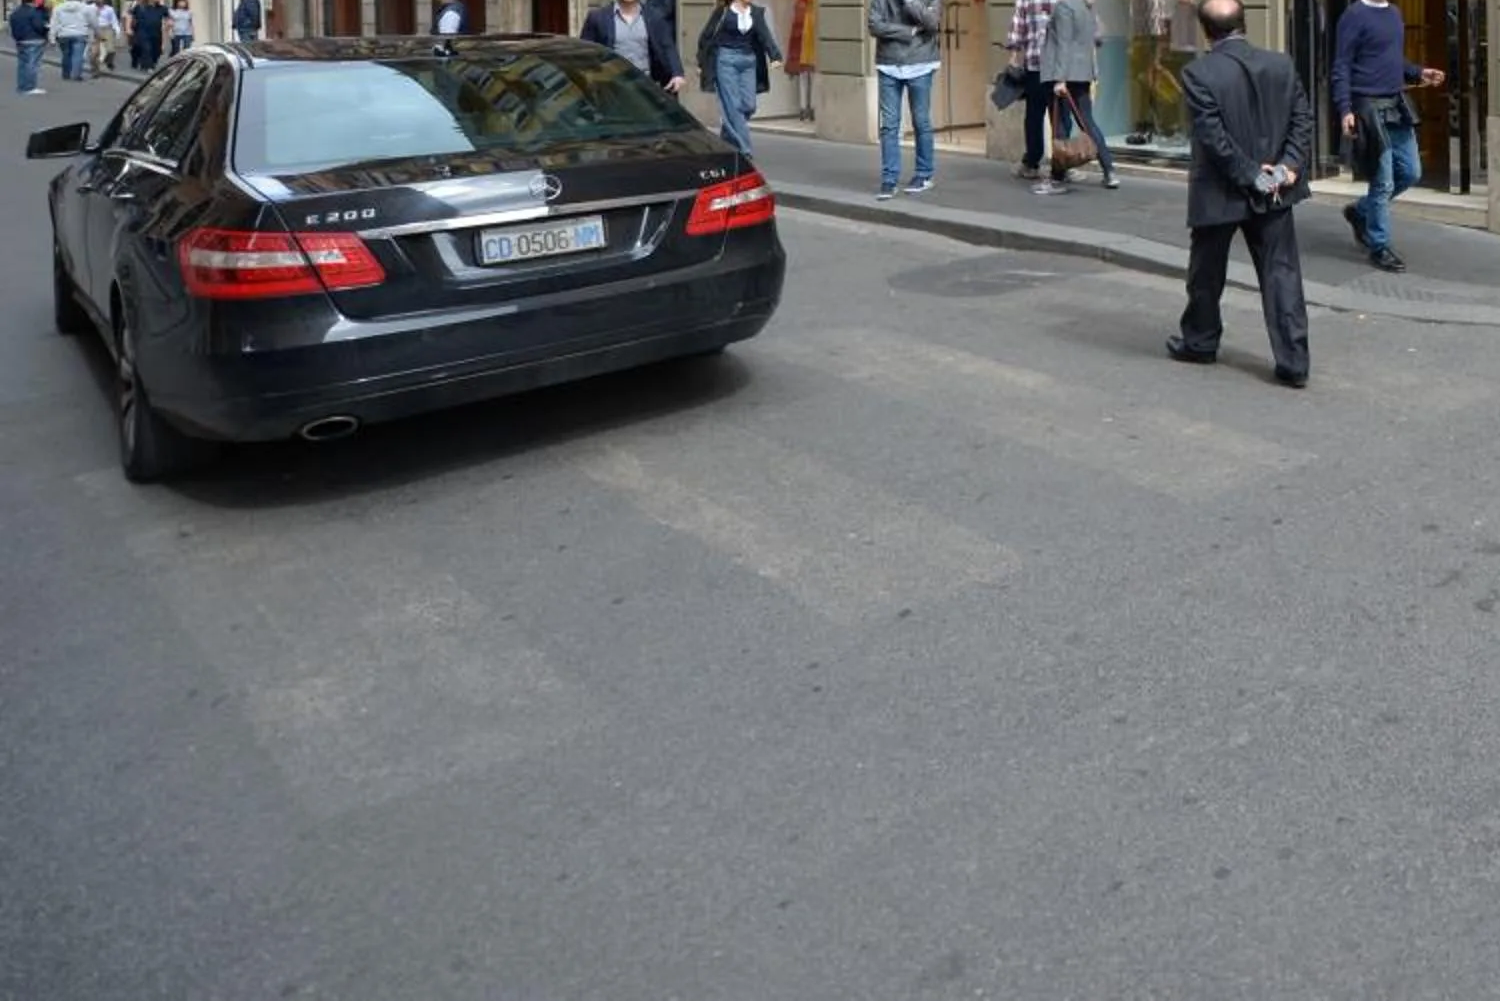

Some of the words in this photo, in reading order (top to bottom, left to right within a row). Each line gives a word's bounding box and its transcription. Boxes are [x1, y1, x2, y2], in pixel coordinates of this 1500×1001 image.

[306, 214, 320, 225] E
[326, 208, 376, 223] 200
[485, 237, 512, 259] CD
[518, 230, 569, 255] 0506
